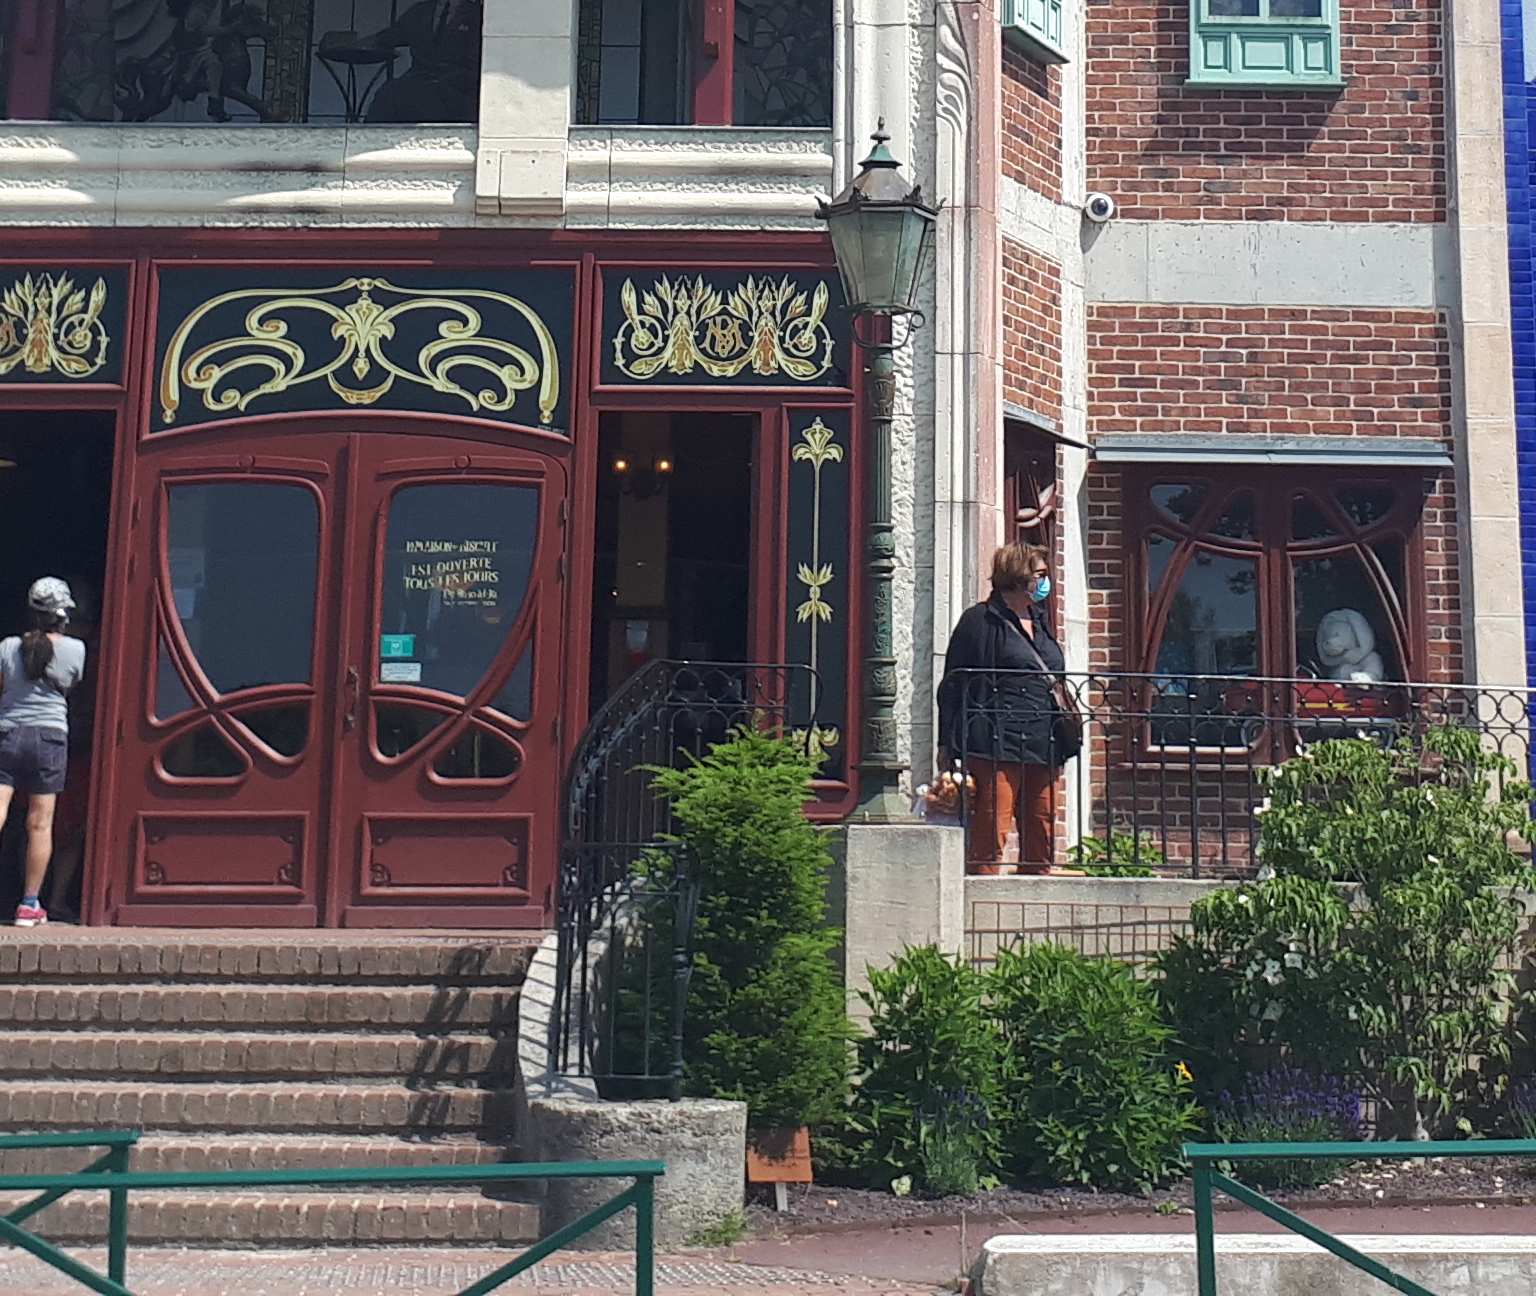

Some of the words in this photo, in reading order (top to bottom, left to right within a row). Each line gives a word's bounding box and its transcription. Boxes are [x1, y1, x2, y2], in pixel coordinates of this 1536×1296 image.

[412, 563, 431, 576] EST
[436, 557, 492, 573] OUVERTE
[404, 576, 435, 590] TOUS
[438, 572, 460, 586] LES
[464, 570, 499, 583] JOURS
